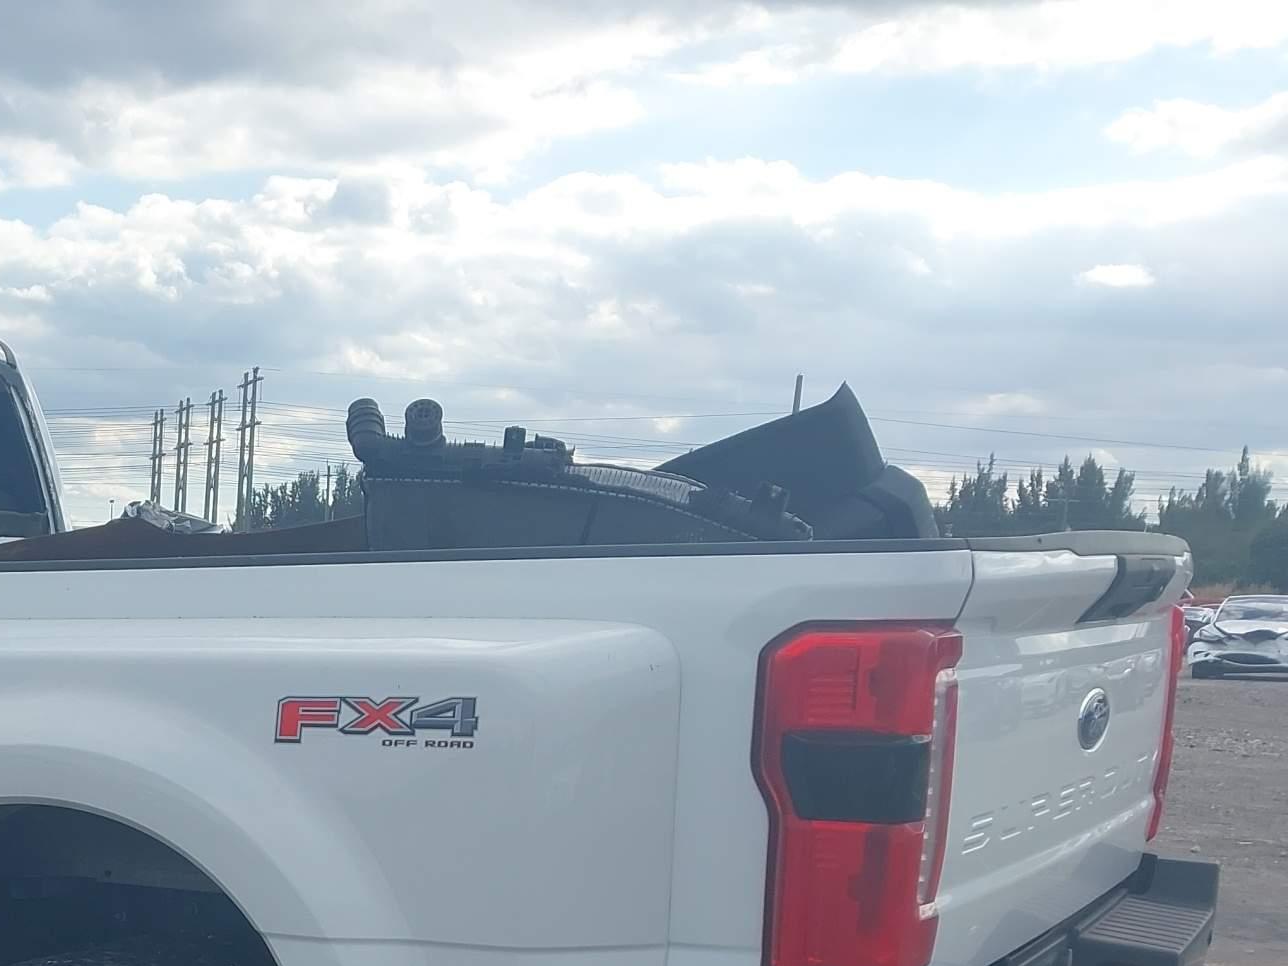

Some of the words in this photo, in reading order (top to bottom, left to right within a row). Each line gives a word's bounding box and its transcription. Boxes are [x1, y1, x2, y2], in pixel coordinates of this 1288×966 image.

[274, 696, 478, 743] FX4
[381, 739, 417, 748] OFF
[424, 739, 474, 749] ROAD
